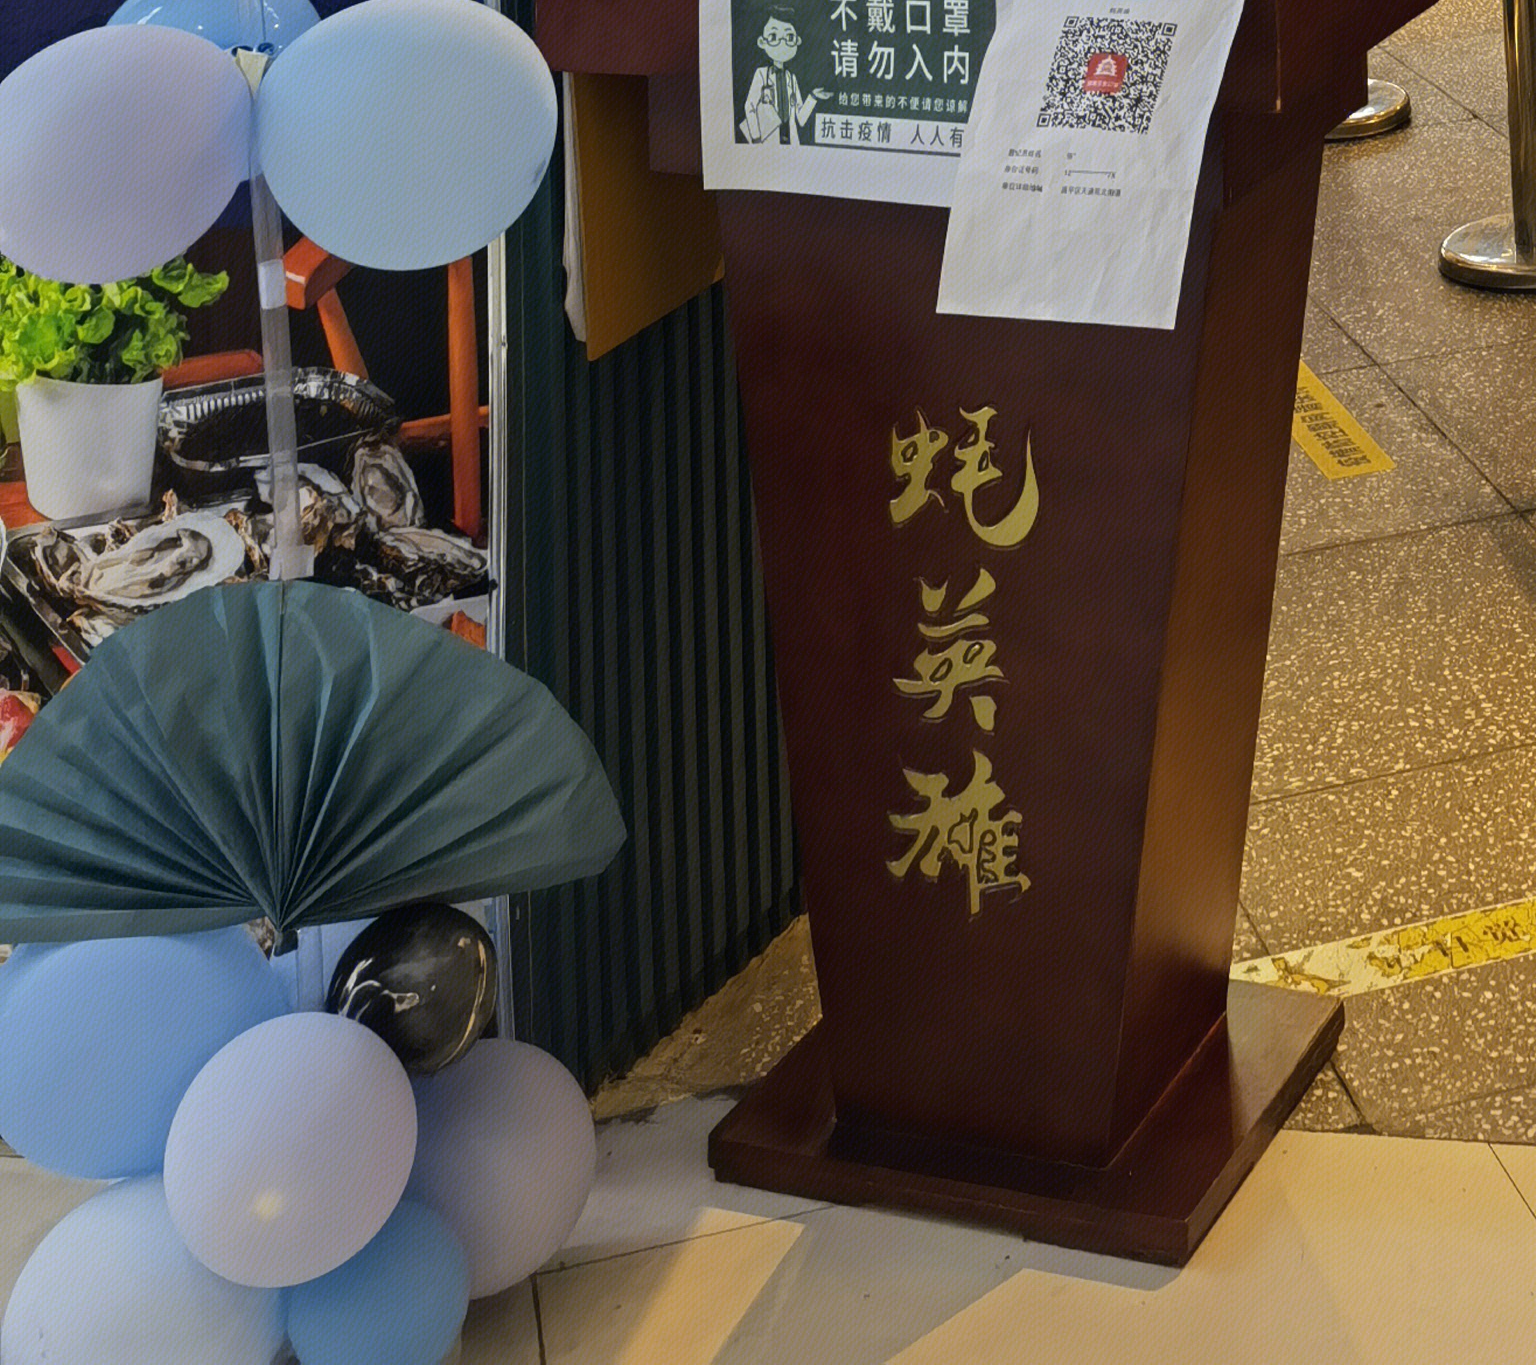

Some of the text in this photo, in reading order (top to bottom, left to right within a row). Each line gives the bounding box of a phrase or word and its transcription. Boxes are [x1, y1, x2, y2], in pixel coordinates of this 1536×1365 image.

[831, 39, 970, 85] 请勿入内
[838, 91, 968, 114] 给您带来的不便请您谅解
[820, 118, 965, 149] 抗击疫情 人人有
[888, 405, 1039, 919] 蚝英雄
